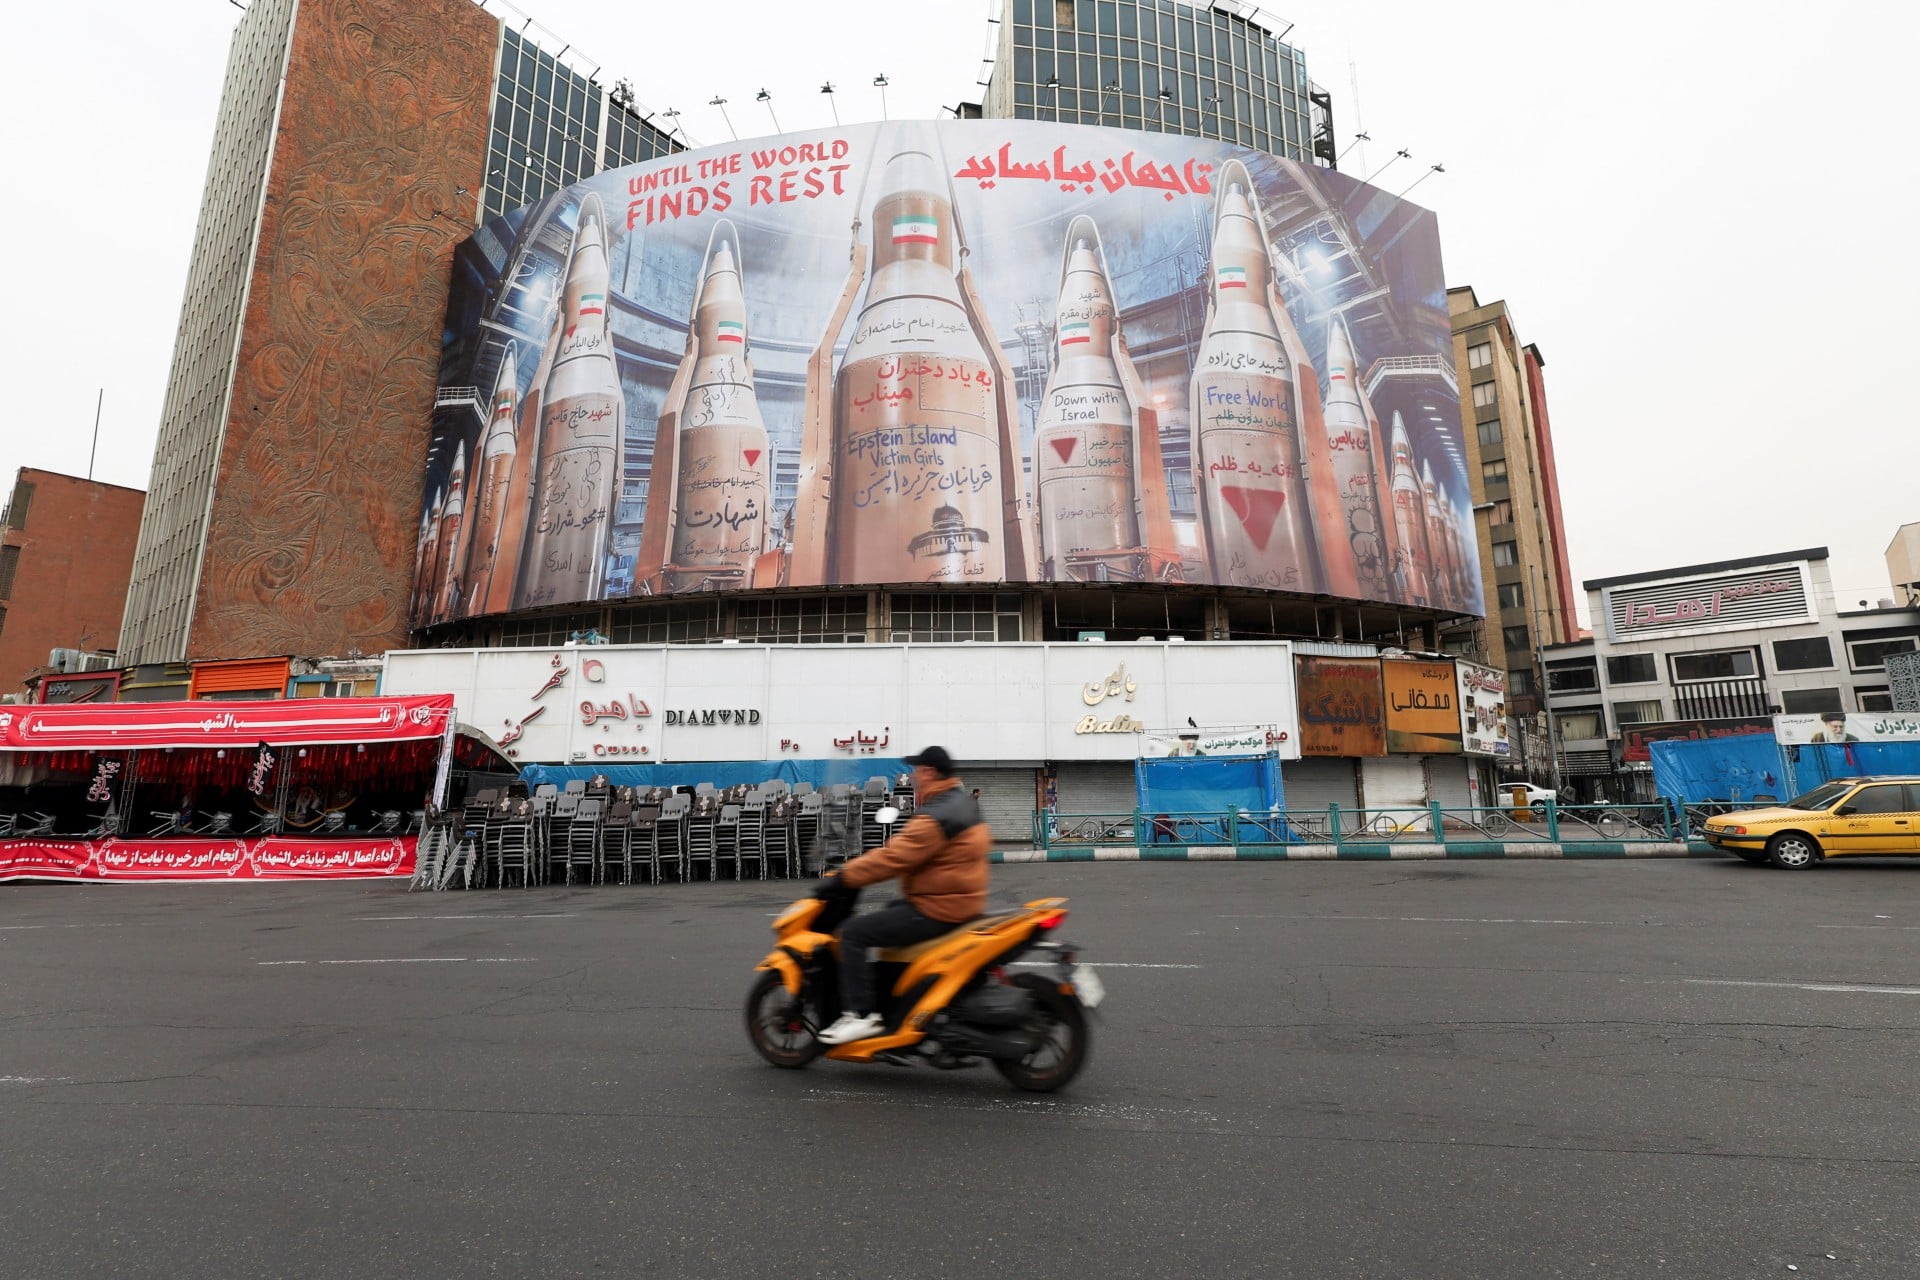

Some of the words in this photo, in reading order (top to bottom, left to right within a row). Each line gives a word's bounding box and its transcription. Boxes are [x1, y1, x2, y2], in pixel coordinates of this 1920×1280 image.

[628, 165, 693, 196] UNTIL
[698, 153, 743, 180] THE
[751, 139, 850, 170] WORLD
[1100, 151, 1188, 202] جهان
[1184, 157, 1214, 195] تا
[626, 180, 732, 231] FINDS
[750, 164, 852, 207] REST
[908, 318, 935, 334] امام
[936, 321, 968, 334] شهید
[877, 357, 944, 381] دختران
[948, 364, 971, 387] یاد
[975, 369, 993, 393] به
[853, 383, 914, 413] میناب
[1054, 394, 1087, 408] Down
[1091, 392, 1119, 404] with
[1206, 386, 1242, 406] Free
[1246, 388, 1289, 411] World
[587, 403, 612, 423] شهید
[1060, 407, 1099, 422] Israel
[848, 426, 904, 460] Epstein
[908, 424, 957, 447] Island
[870, 450, 912, 468] Victim
[914, 448, 945, 467] Girls
[938, 464, 993, 494] قربانیان
[685, 498, 759, 532] شهادت
[1075, 714, 1146, 736] Balin
[1874, 718, 1918, 735] برادران
[832, 726, 890, 754] زیبایی
